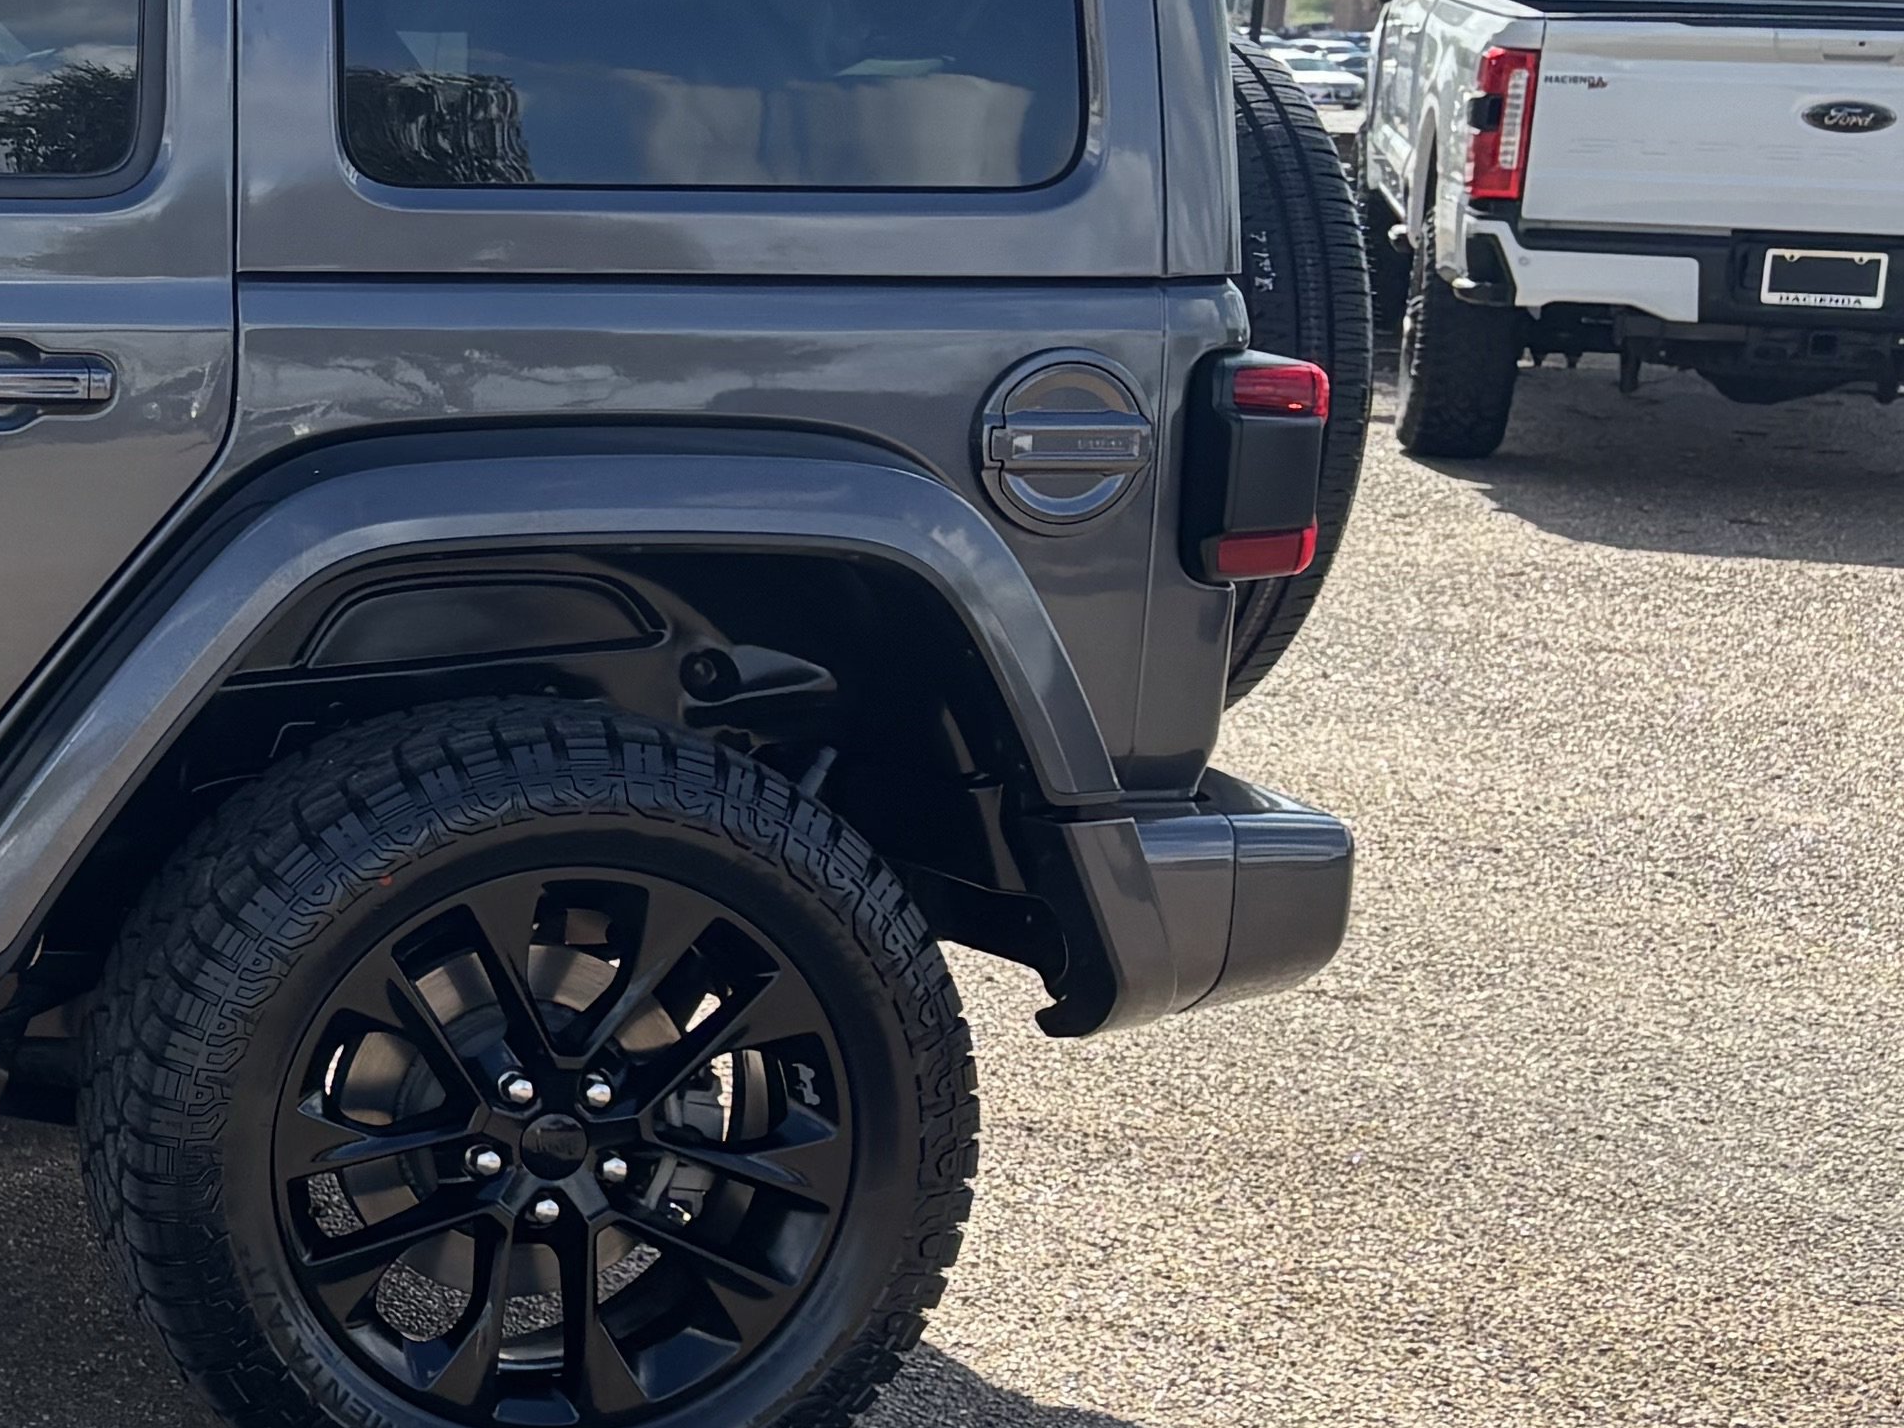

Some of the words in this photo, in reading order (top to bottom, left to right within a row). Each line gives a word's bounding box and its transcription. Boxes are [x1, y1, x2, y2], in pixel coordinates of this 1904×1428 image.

[1544, 75, 1604, 85] HACIENDA
[1823, 106, 1876, 127] Ford
[1778, 294, 1863, 308] HACIENDA
